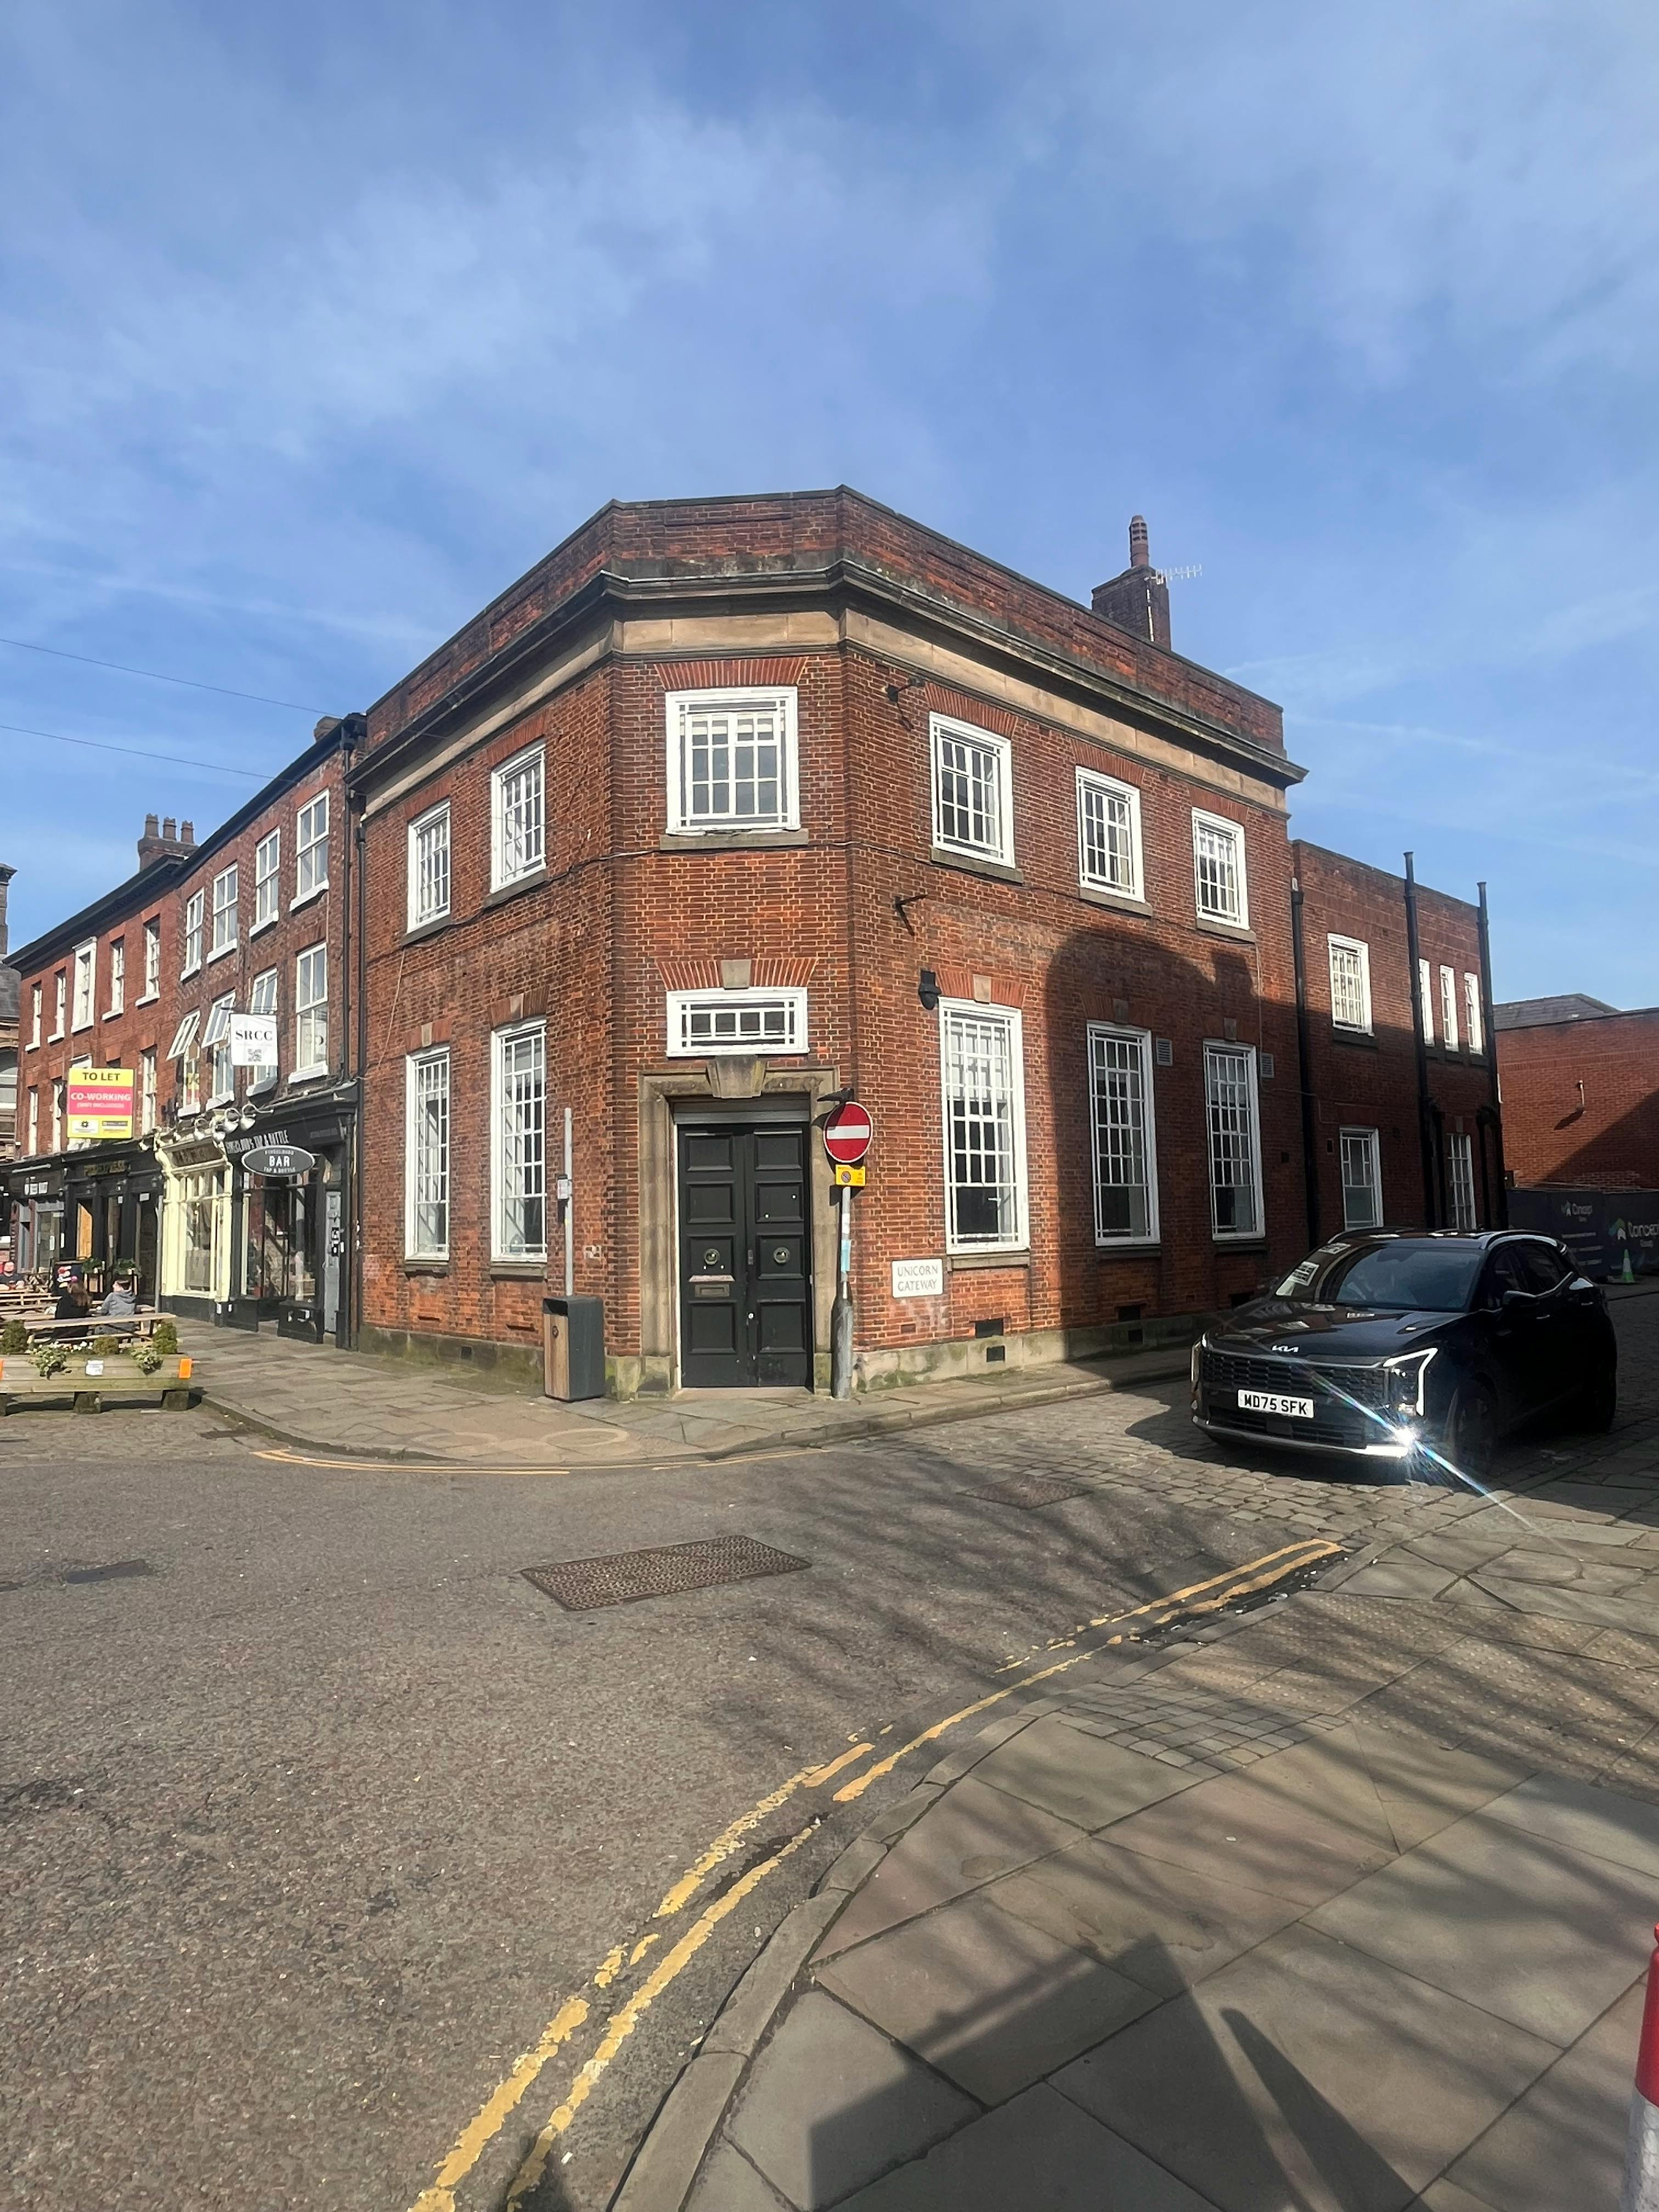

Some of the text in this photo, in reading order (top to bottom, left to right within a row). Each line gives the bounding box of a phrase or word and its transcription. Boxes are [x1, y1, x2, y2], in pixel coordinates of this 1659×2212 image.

[235, 1030, 273, 1041] SRCC
[82, 1071, 121, 1081] TO LET
[71, 1092, 132, 1101] CO-WORKING
[269, 1155, 290, 1167] BAR
[898, 1265, 938, 1277] UNICORN
[898, 1279, 936, 1291] GATEWAY
[1281, 1399, 1307, 1415] SFK
